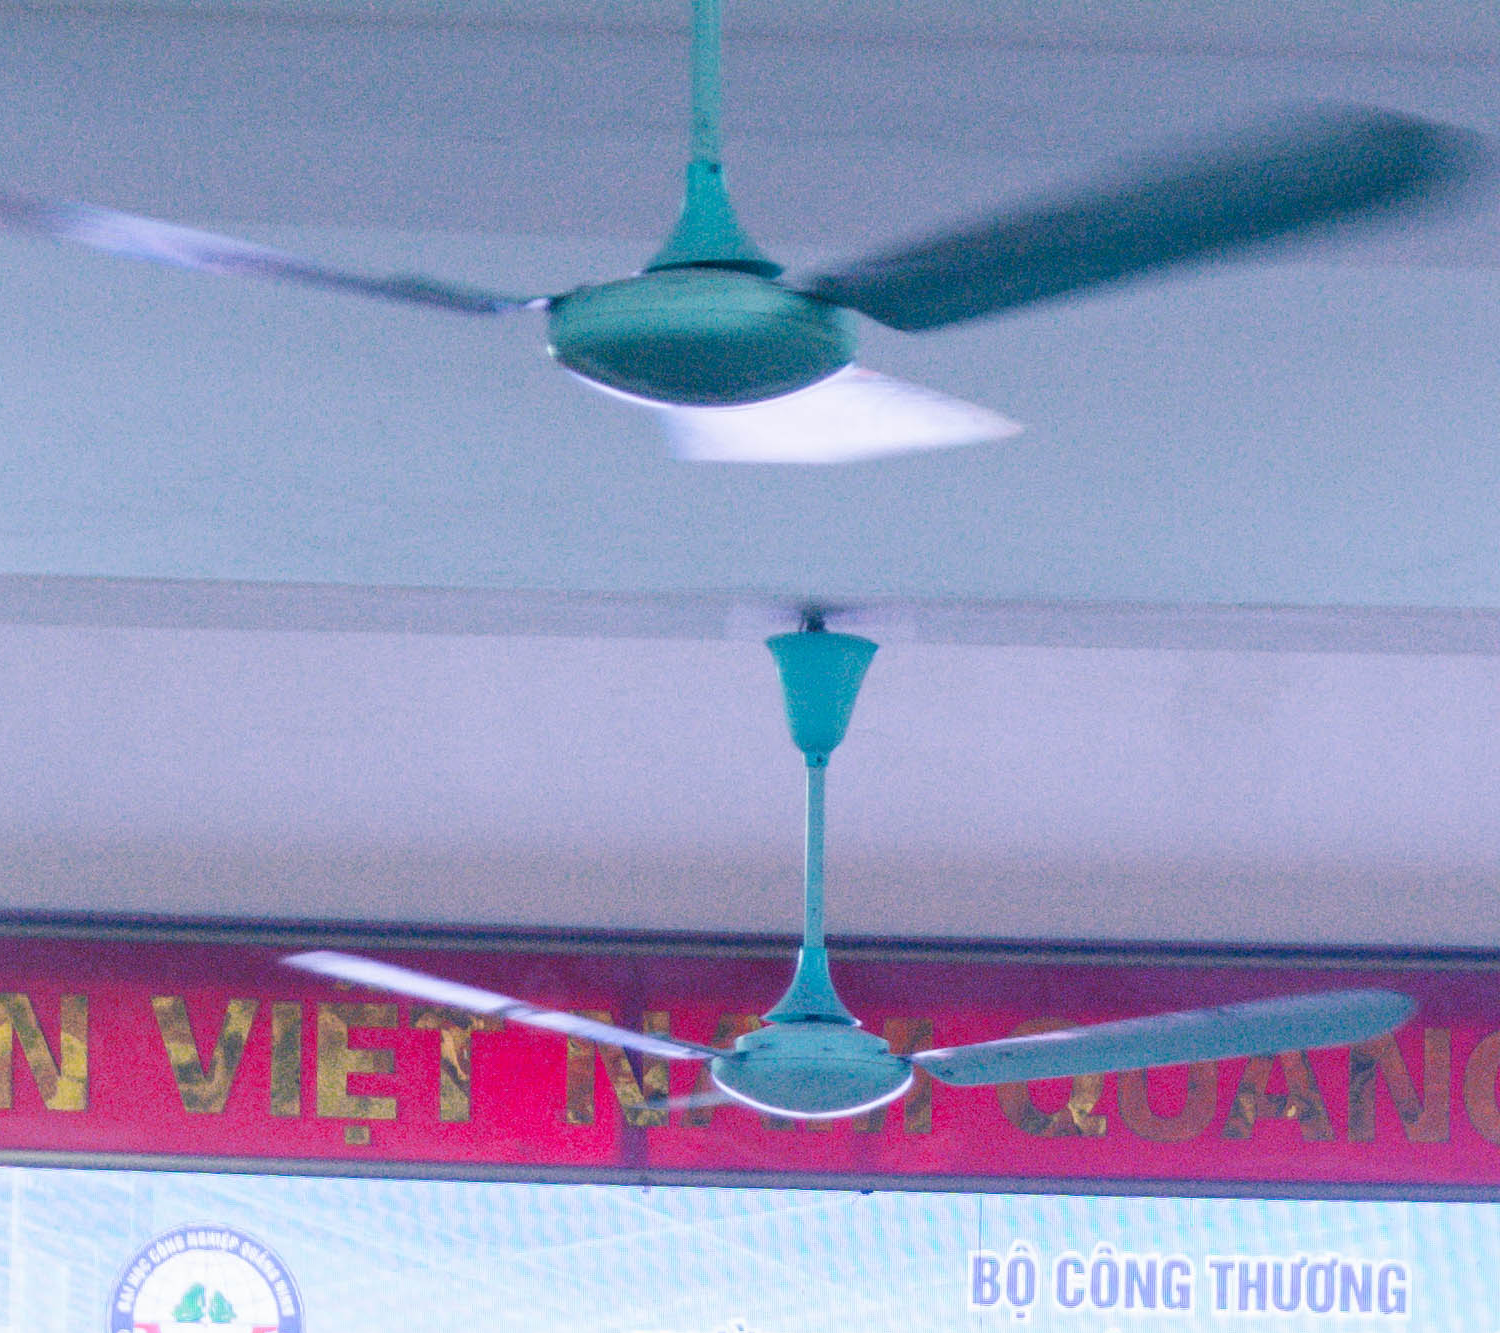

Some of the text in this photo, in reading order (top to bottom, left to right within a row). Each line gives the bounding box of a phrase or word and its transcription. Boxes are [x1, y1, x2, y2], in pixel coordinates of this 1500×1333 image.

[151, 983, 504, 1145] VIỆT
[970, 1246, 1407, 1319] BỘ CÔNG THƯƠNG
